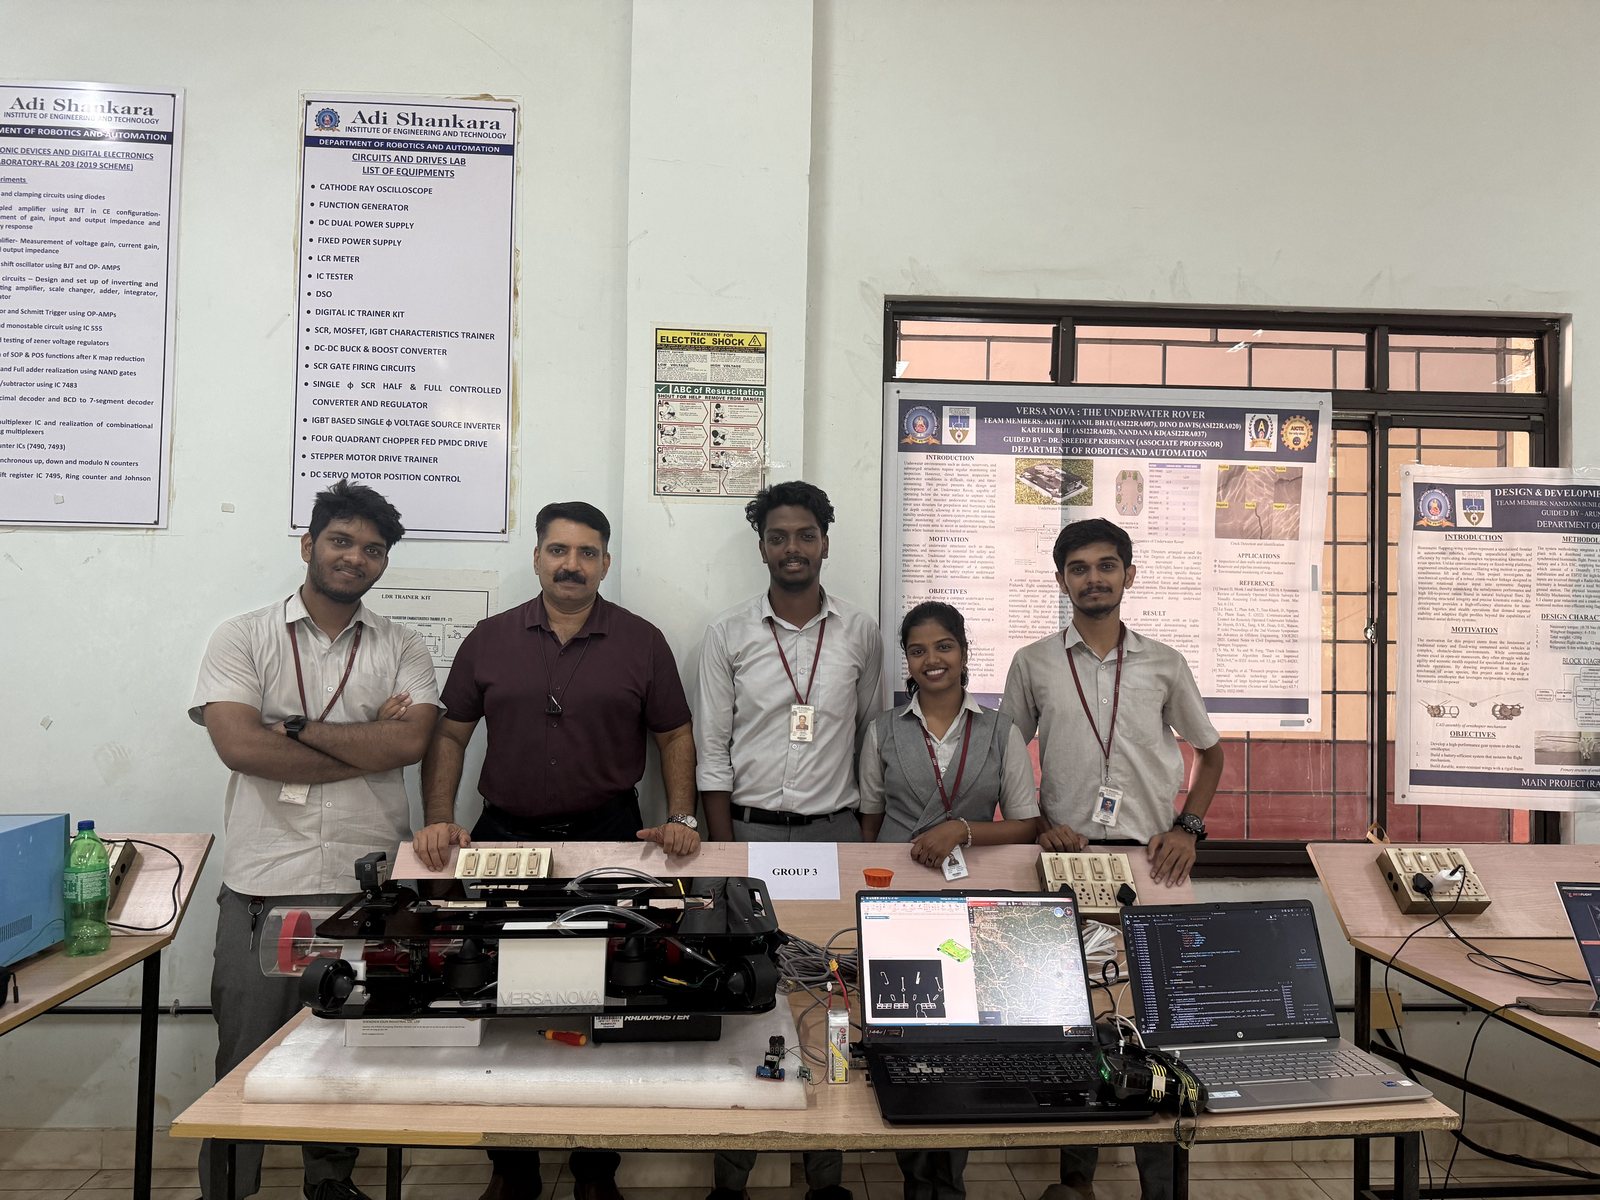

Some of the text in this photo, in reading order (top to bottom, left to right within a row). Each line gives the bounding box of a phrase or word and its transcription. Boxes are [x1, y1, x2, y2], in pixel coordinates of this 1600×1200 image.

[9, 97, 44, 111] Adi
[3, 111, 37, 119] INSTITUTE
[114, 116, 159, 124] TECHNOLOGY
[351, 110, 500, 130] Adi Shankara
[37, 128, 81, 136] ROBOTICS
[104, 131, 167, 141] AUTOMATION
[393, 127, 441, 136] ENGINEERING
[460, 130, 506, 139] TECHNOLOGY
[319, 138, 372, 147] DEPARTMENT
[386, 141, 424, 149] ROBOTICS
[445, 144, 500, 152] AUTOMATION
[20, 147, 51, 155] DEVICES
[72, 149, 102, 157] DIGITAL
[103, 151, 153, 160] ELECTRONICS
[352, 153, 466, 166] CIRCUITS AND DRIVES LAB
[362, 167, 455, 178] LIST OF EQUIPMENTS
[319, 183, 432, 194] CATHODE RAY OSCILLOSCOPE
[319, 201, 408, 211] FUNCTION GENERATOR
[318, 218, 414, 229] DC DUAL POWER SUPPLY
[317, 254, 331, 262] LCR
[316, 290, 332, 298] DSO
[64, 324, 82, 332] using
[314, 326, 495, 340] SCR, MOSFET, IGBT CHARACTERISTICS TRAINER
[660, 336, 744, 346] ELECTRIC SHOCK
[674, 386, 691, 394] ABC
[705, 387, 764, 395] Resuscitation
[1016, 406, 1047, 415] VERSA
[1049, 407, 1075, 415] NOVA
[1081, 408, 1101, 416] THE
[1104, 408, 1169, 418] UNDERWATER
[1172, 410, 1205, 419] ROVER
[1118, 428, 1153, 436] NANDANA
[311, 434, 333, 442] FOUR
[334, 435, 380, 443] QUADRANT
[382, 436, 419, 445] CHOPPER
[438, 438, 462, 446] PMDC
[464, 439, 488, 448] DRIVE
[1135, 438, 1178, 447] (ASSOCIATE
[1179, 440, 1223, 448] PROFESSOR)
[1011, 445, 1207, 457] DEPARTMENT OF ROBOTICS AND AUTOMATION
[9, 471, 34, 479] register
[45, 472, 63, 480] 7495,
[65, 472, 79, 480] Ring
[1495, 488, 1532, 496] DESIGN
[1537, 520, 1590, 529] DEPARTMENT
[1450, 730, 1496, 738] OBJECTIVES
[1521, 778, 1585, 788] MAIN PROJECT
[772, 868, 818, 876] GROUP 3
[499, 990, 601, 1005] VERSA NOVA
